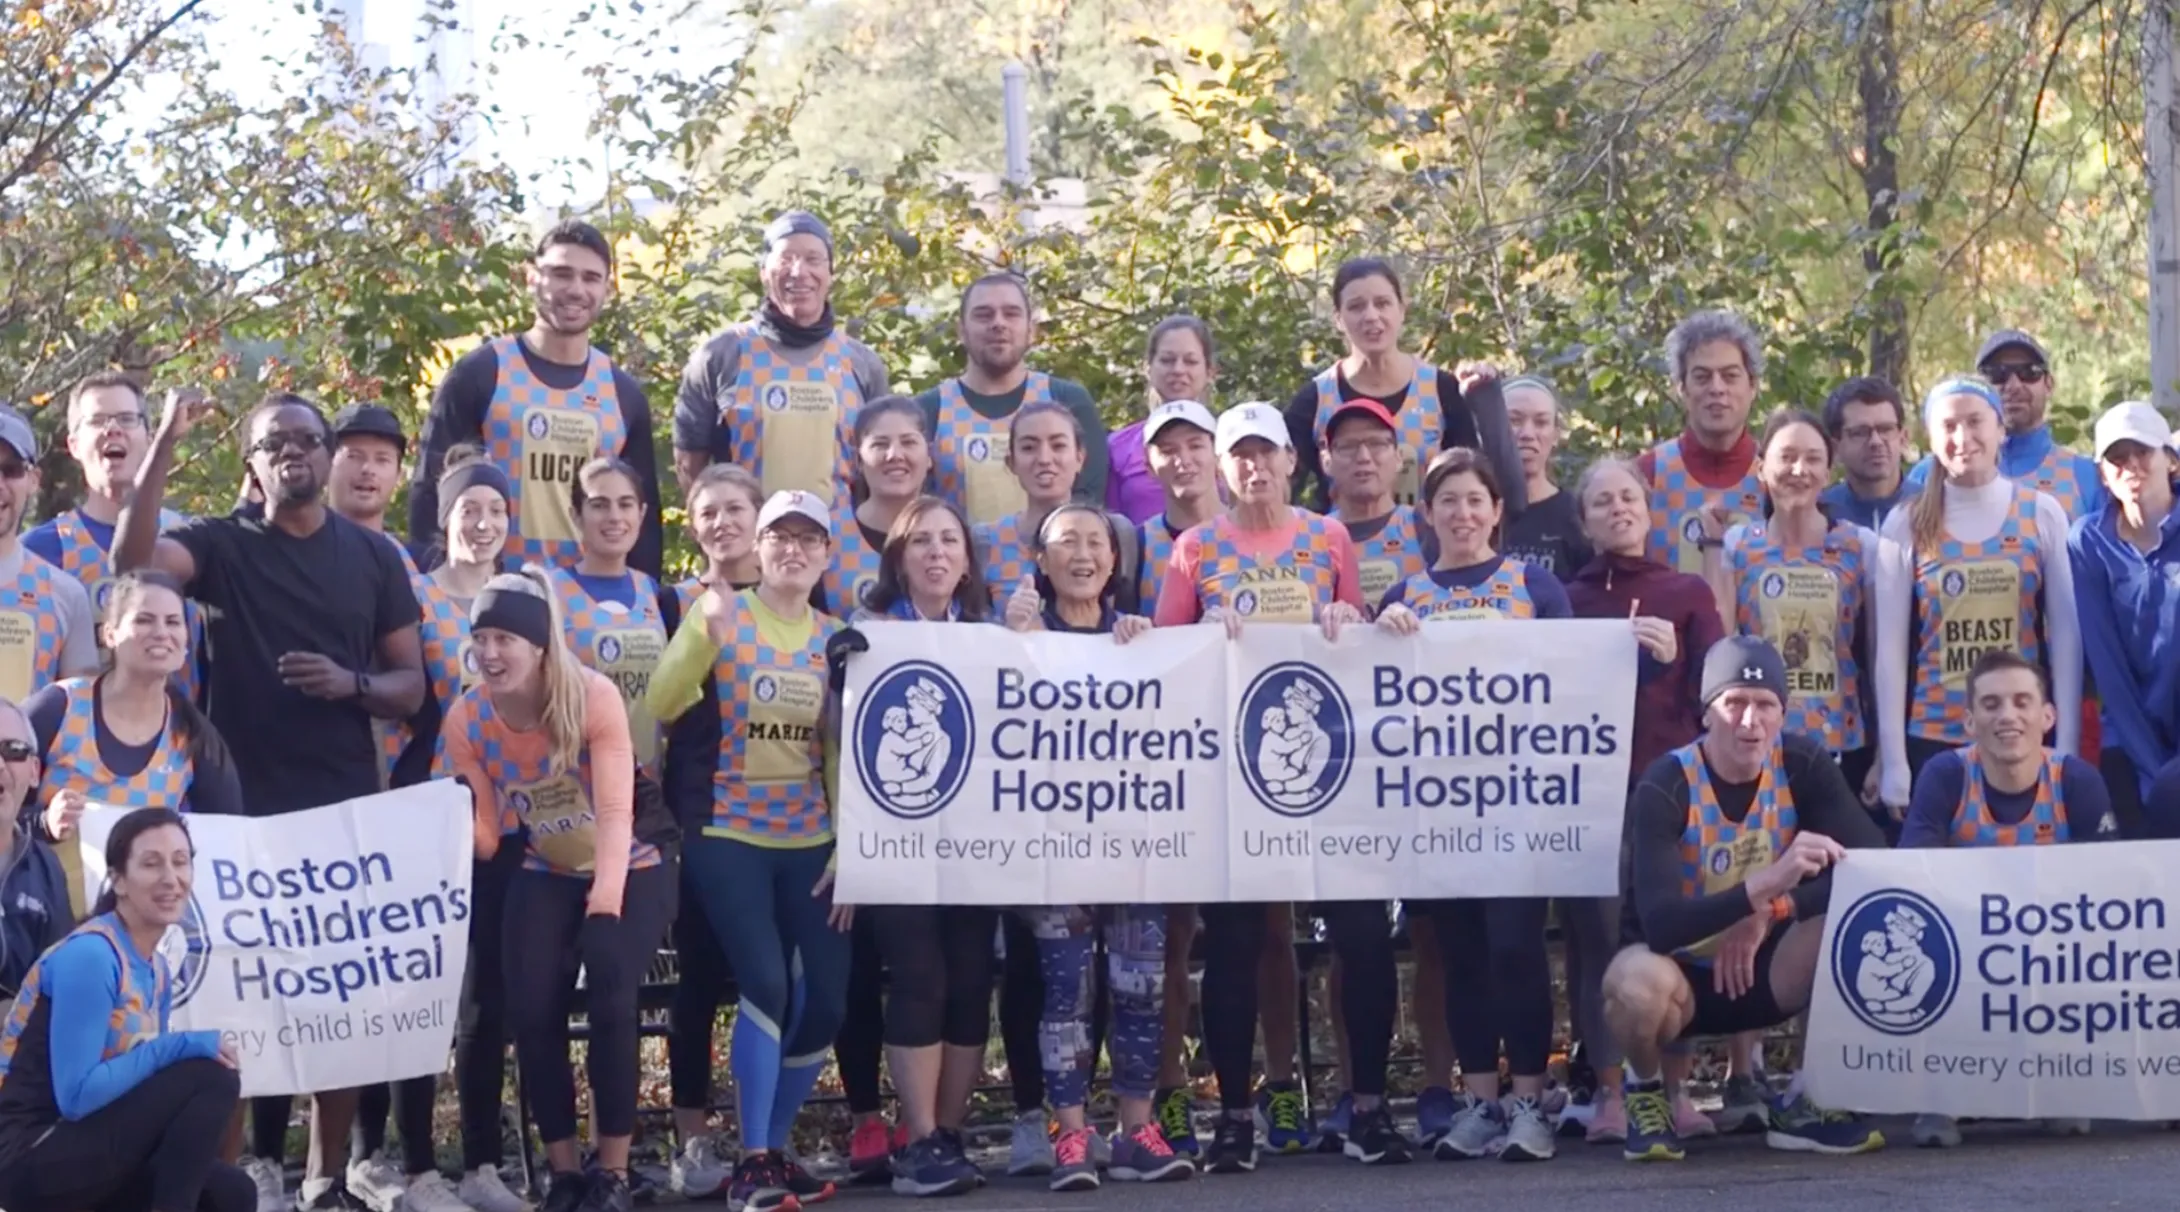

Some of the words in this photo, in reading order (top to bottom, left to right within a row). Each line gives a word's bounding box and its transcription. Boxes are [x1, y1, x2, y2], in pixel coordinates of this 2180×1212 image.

[1238, 567, 1298, 583] ANN
[1945, 617, 2014, 643] BEAST
[996, 666, 1163, 711] Boston
[1373, 664, 1551, 708] Boston
[1785, 671, 1835, 692] EEM
[747, 722, 814, 741] MARIE
[991, 717, 1220, 762] Children's
[1371, 712, 1617, 758] Children's
[992, 768, 1186, 823] Hospital
[1375, 763, 1581, 818] Hospital
[539, 813, 594, 834] ARA
[1243, 829, 1310, 858] Until
[1320, 836, 1402, 862] every
[1412, 827, 1483, 854] child
[1493, 827, 1515, 853] is
[858, 831, 925, 860] Until
[935, 838, 1016, 866] every
[1025, 832, 1092, 860] child
[1102, 832, 1122, 860] is
[211, 851, 393, 901] Boston
[222, 880, 468, 948] Children's
[1980, 893, 2166, 936] Boston
[232, 934, 443, 1003] Hospital
[1977, 939, 2180, 986] Childre
[222, 1029, 268, 1057] ery
[277, 1009, 352, 1048] child
[363, 1009, 385, 1038] is
[1981, 989, 2180, 1043] Hospita
[1842, 1044, 1913, 1074] Until
[1923, 1053, 2008, 1083] every
[2018, 1051, 2093, 1078] child
[2105, 1052, 2128, 1077] is
[2137, 1054, 2180, 1077] we
